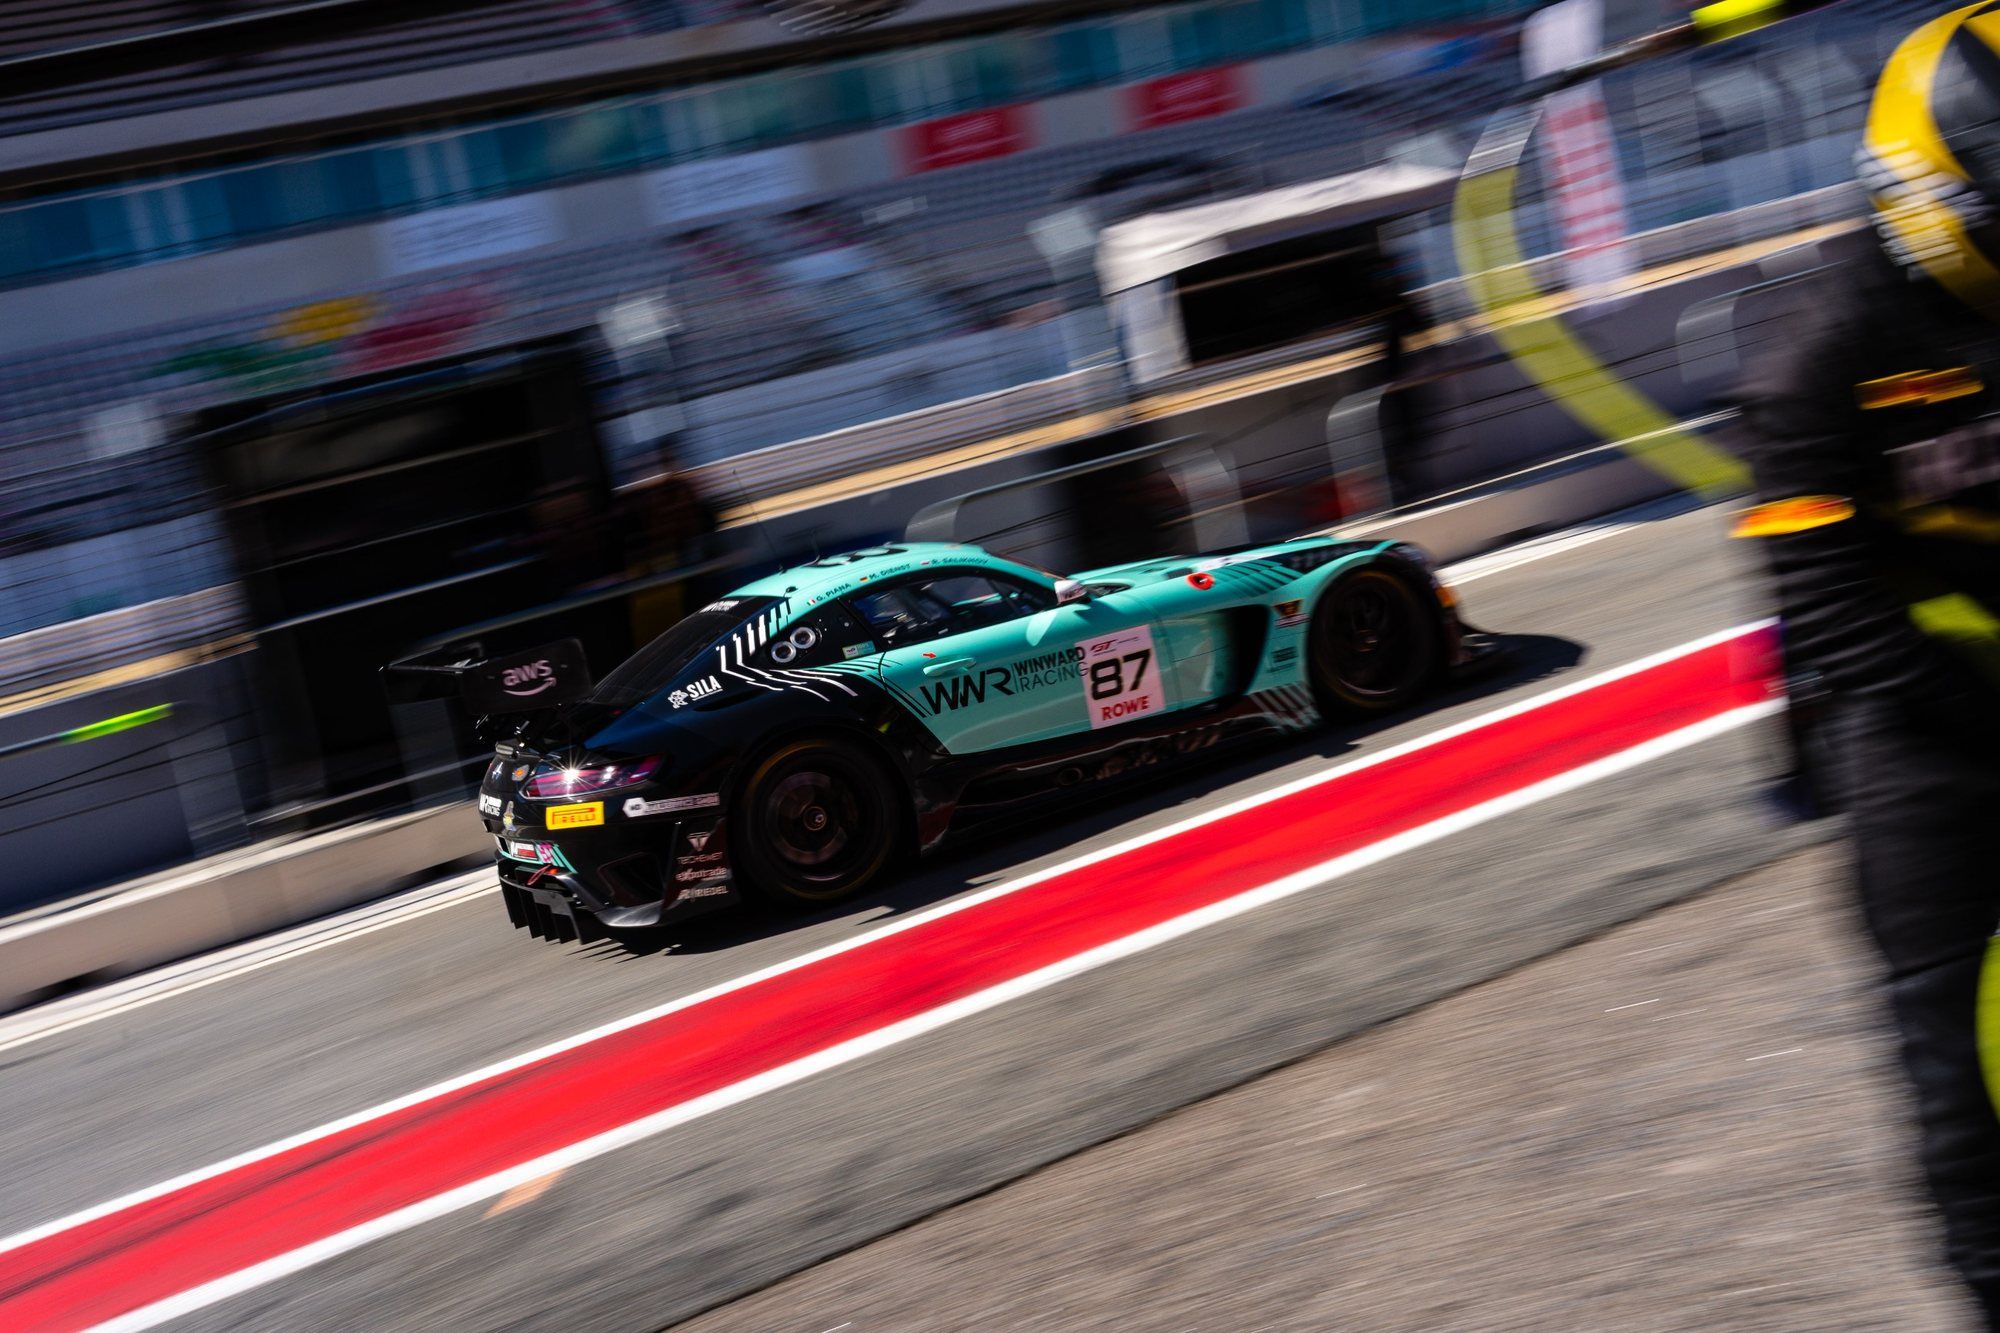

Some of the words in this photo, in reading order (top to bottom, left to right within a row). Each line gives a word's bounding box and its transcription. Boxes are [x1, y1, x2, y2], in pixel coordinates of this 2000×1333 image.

[826, 583, 852, 598] PIANA
[1090, 639, 1118, 652] GT
[502, 660, 552, 686] aws
[1013, 646, 1086, 676] WINWARD
[686, 675, 722, 698] SILA
[1020, 661, 1089, 693] RACING
[1090, 649, 1152, 700] 87
[1101, 695, 1150, 721] ROWE
